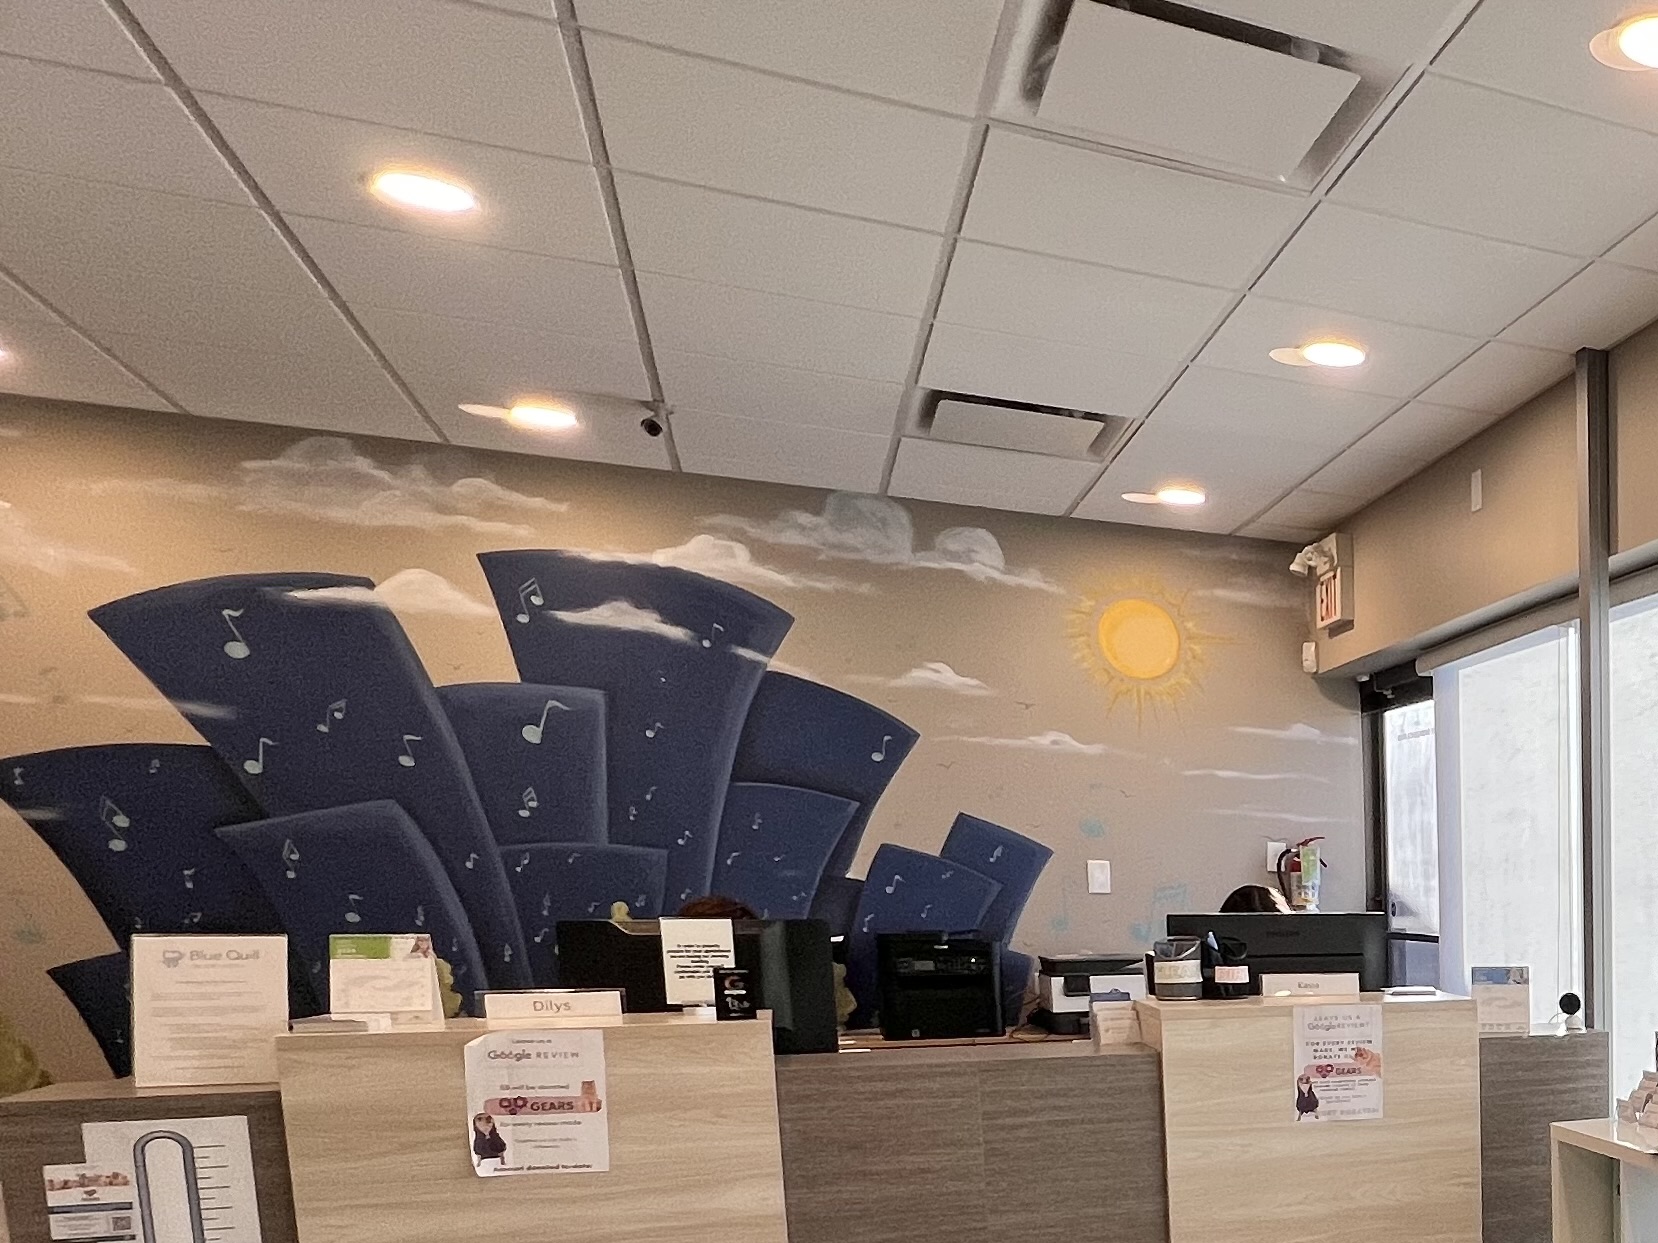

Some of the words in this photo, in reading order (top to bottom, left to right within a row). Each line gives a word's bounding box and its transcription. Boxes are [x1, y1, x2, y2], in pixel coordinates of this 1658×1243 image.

[190, 950, 223, 961] Blue
[533, 1000, 571, 1014] Dilys
[487, 1049, 532, 1062] Google
[535, 1051, 579, 1060] REVIEW
[530, 1101, 574, 1112] GEARS
